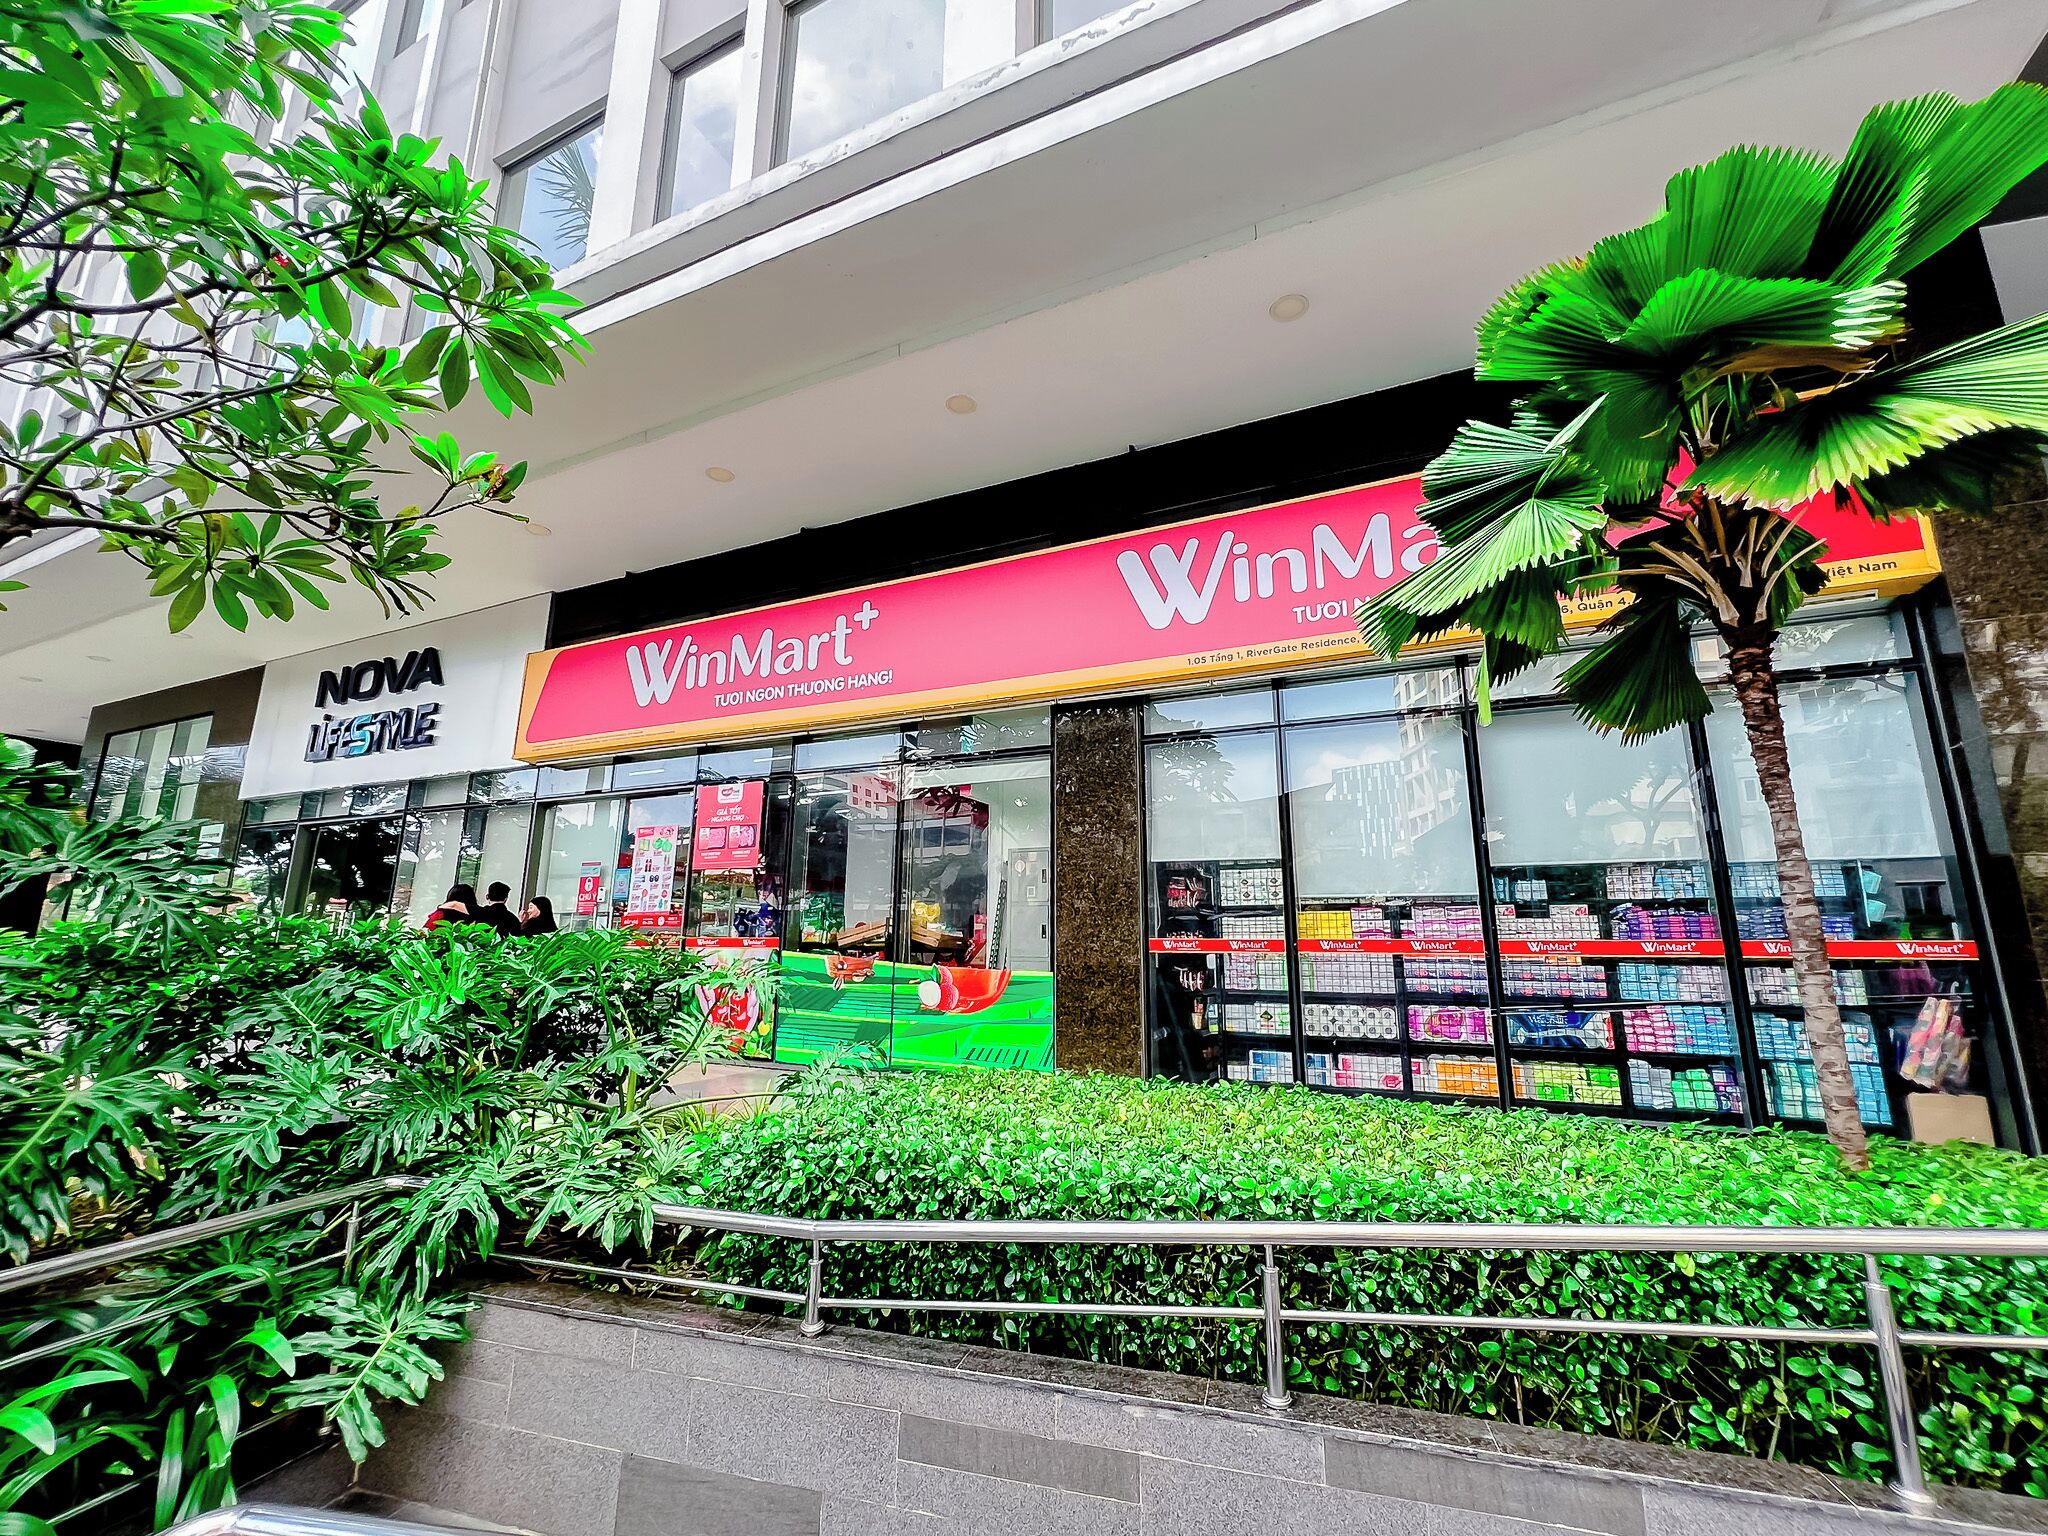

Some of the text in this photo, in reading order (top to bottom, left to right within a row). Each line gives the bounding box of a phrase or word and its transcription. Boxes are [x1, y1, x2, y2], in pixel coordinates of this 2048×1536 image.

[1187, 656, 1207, 666] 1.05
[1236, 651, 1244, 660] 1,
[1246, 643, 1298, 658] RiverGate
[1301, 635, 1360, 650] Residence,
[1577, 600, 1613, 611] Quận
[1858, 561, 1897, 573] Nam
[1292, 599, 1349, 624] TƯƠI
[314, 647, 445, 709] NOVA
[745, 684, 785, 704] NGON
[847, 669, 893, 691] HẠNG!
